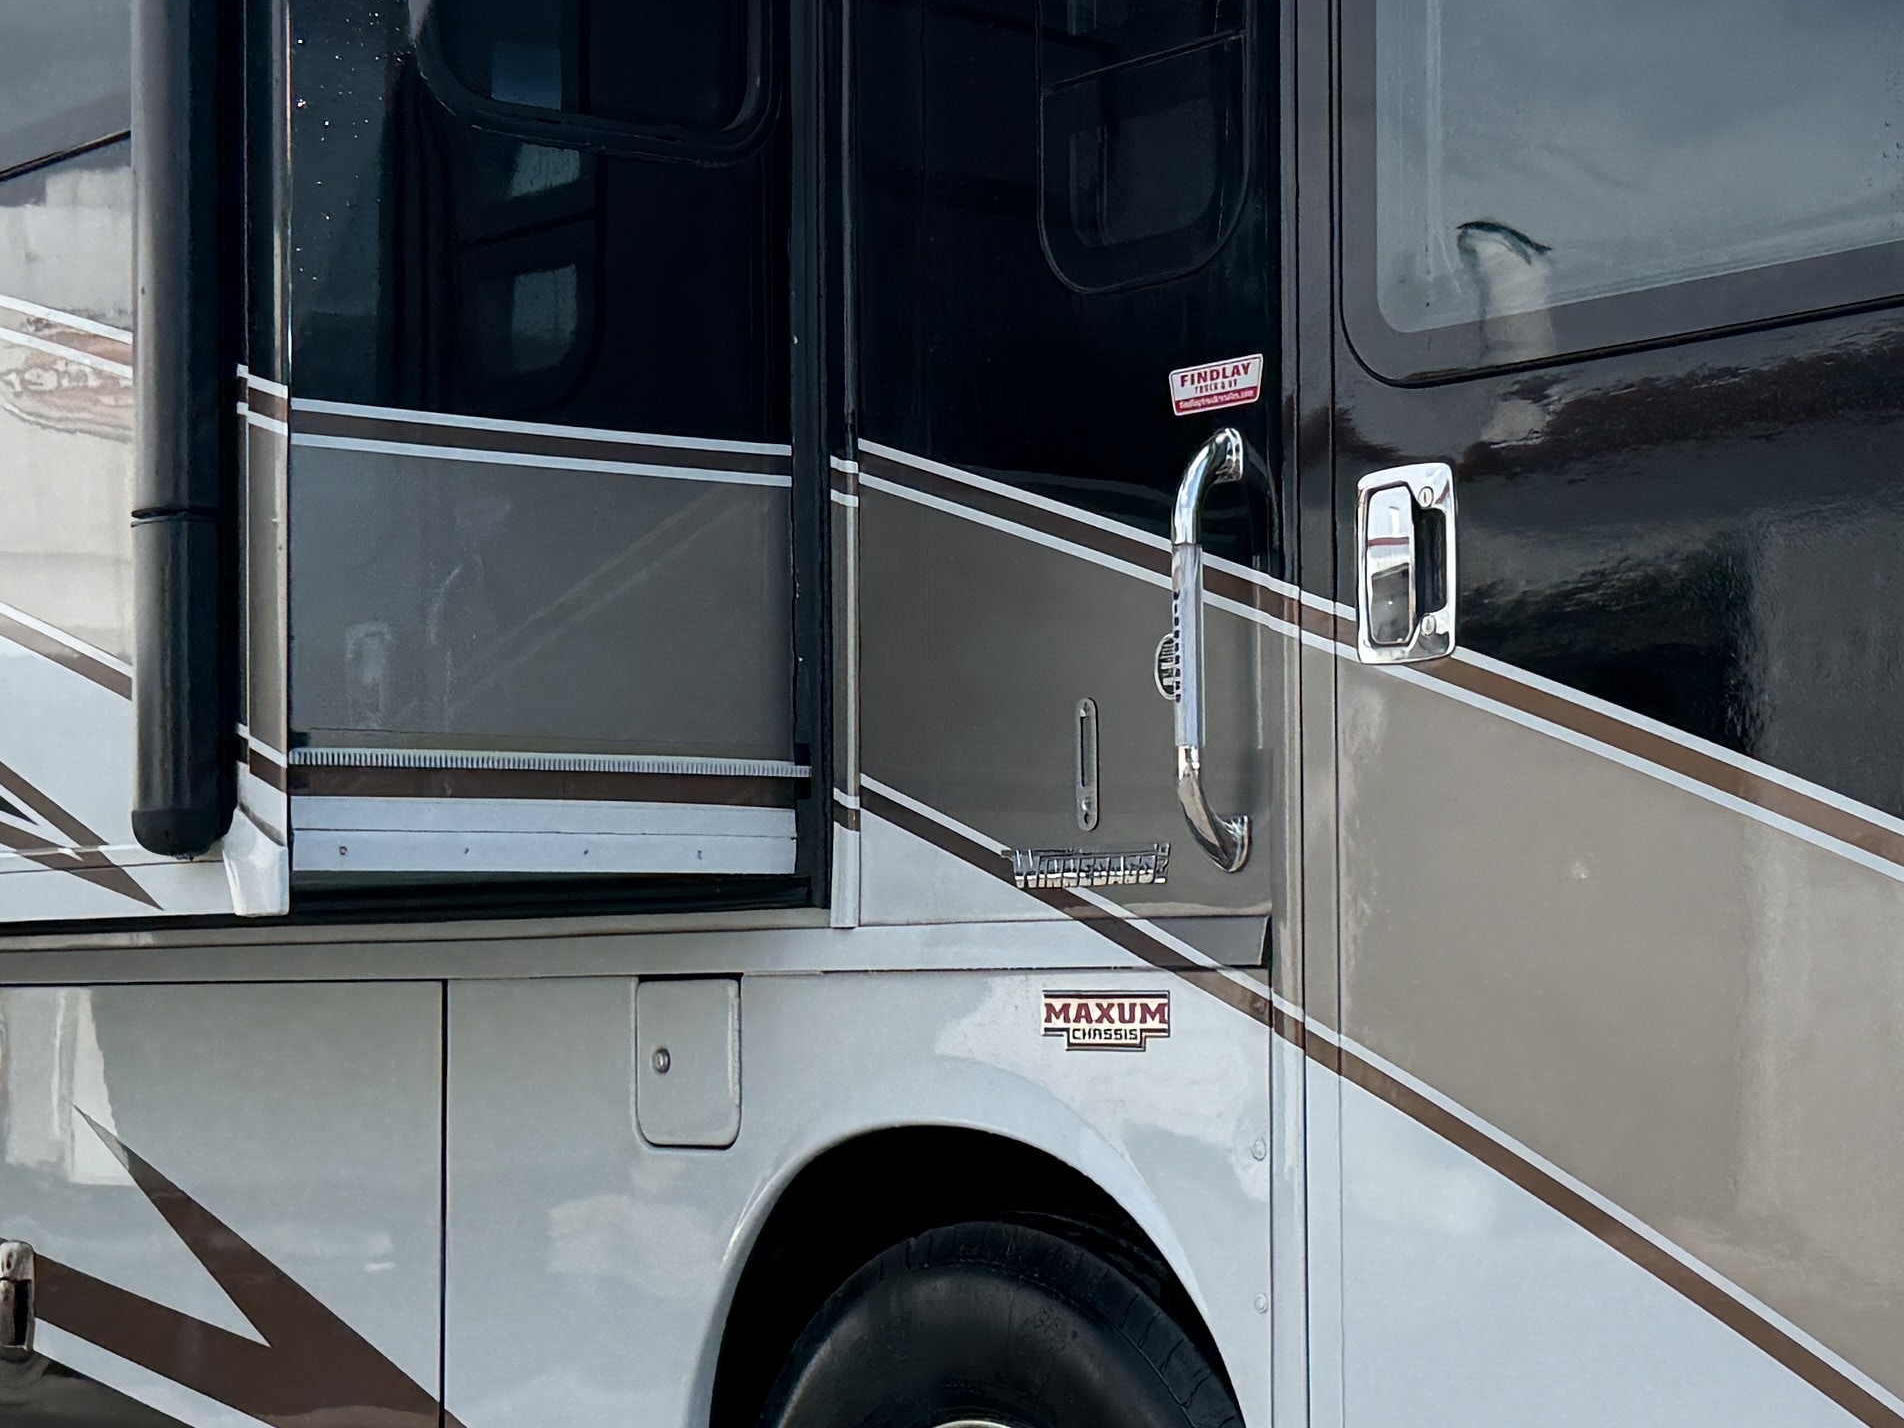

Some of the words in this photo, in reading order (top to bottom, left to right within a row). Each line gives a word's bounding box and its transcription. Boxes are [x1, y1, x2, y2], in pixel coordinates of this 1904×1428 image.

[1180, 363, 1251, 387] FINDLAY
[1044, 1002, 1168, 1024] MAXUM
[1072, 1028, 1139, 1041] CHASSIS
